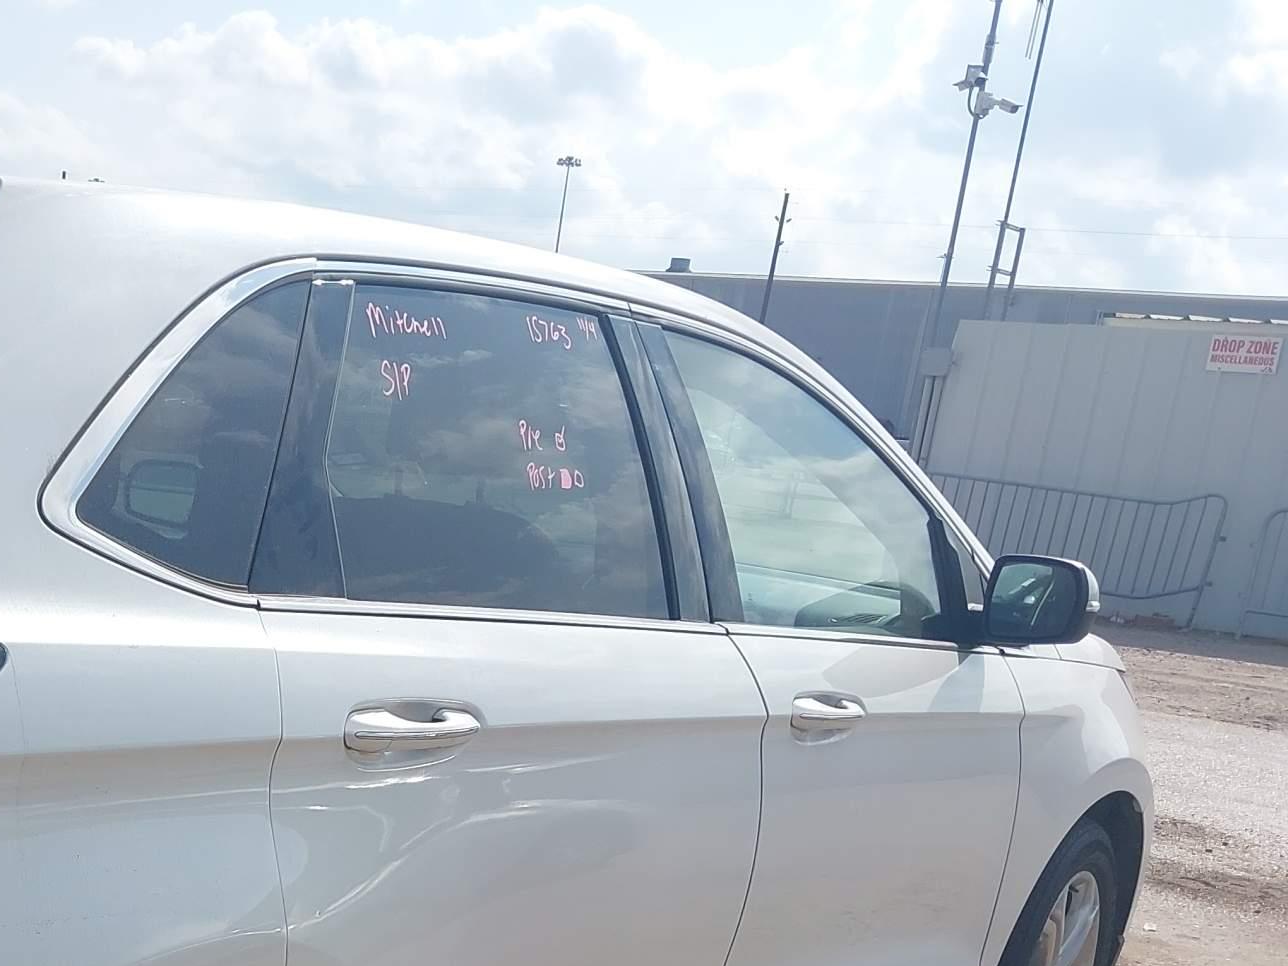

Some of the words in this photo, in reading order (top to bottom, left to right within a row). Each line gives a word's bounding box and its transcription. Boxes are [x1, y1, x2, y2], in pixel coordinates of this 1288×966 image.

[1212, 338, 1245, 354] DROP
[1246, 340, 1280, 355] ZONE
[1210, 354, 1275, 367] MISCELLANEOUS
